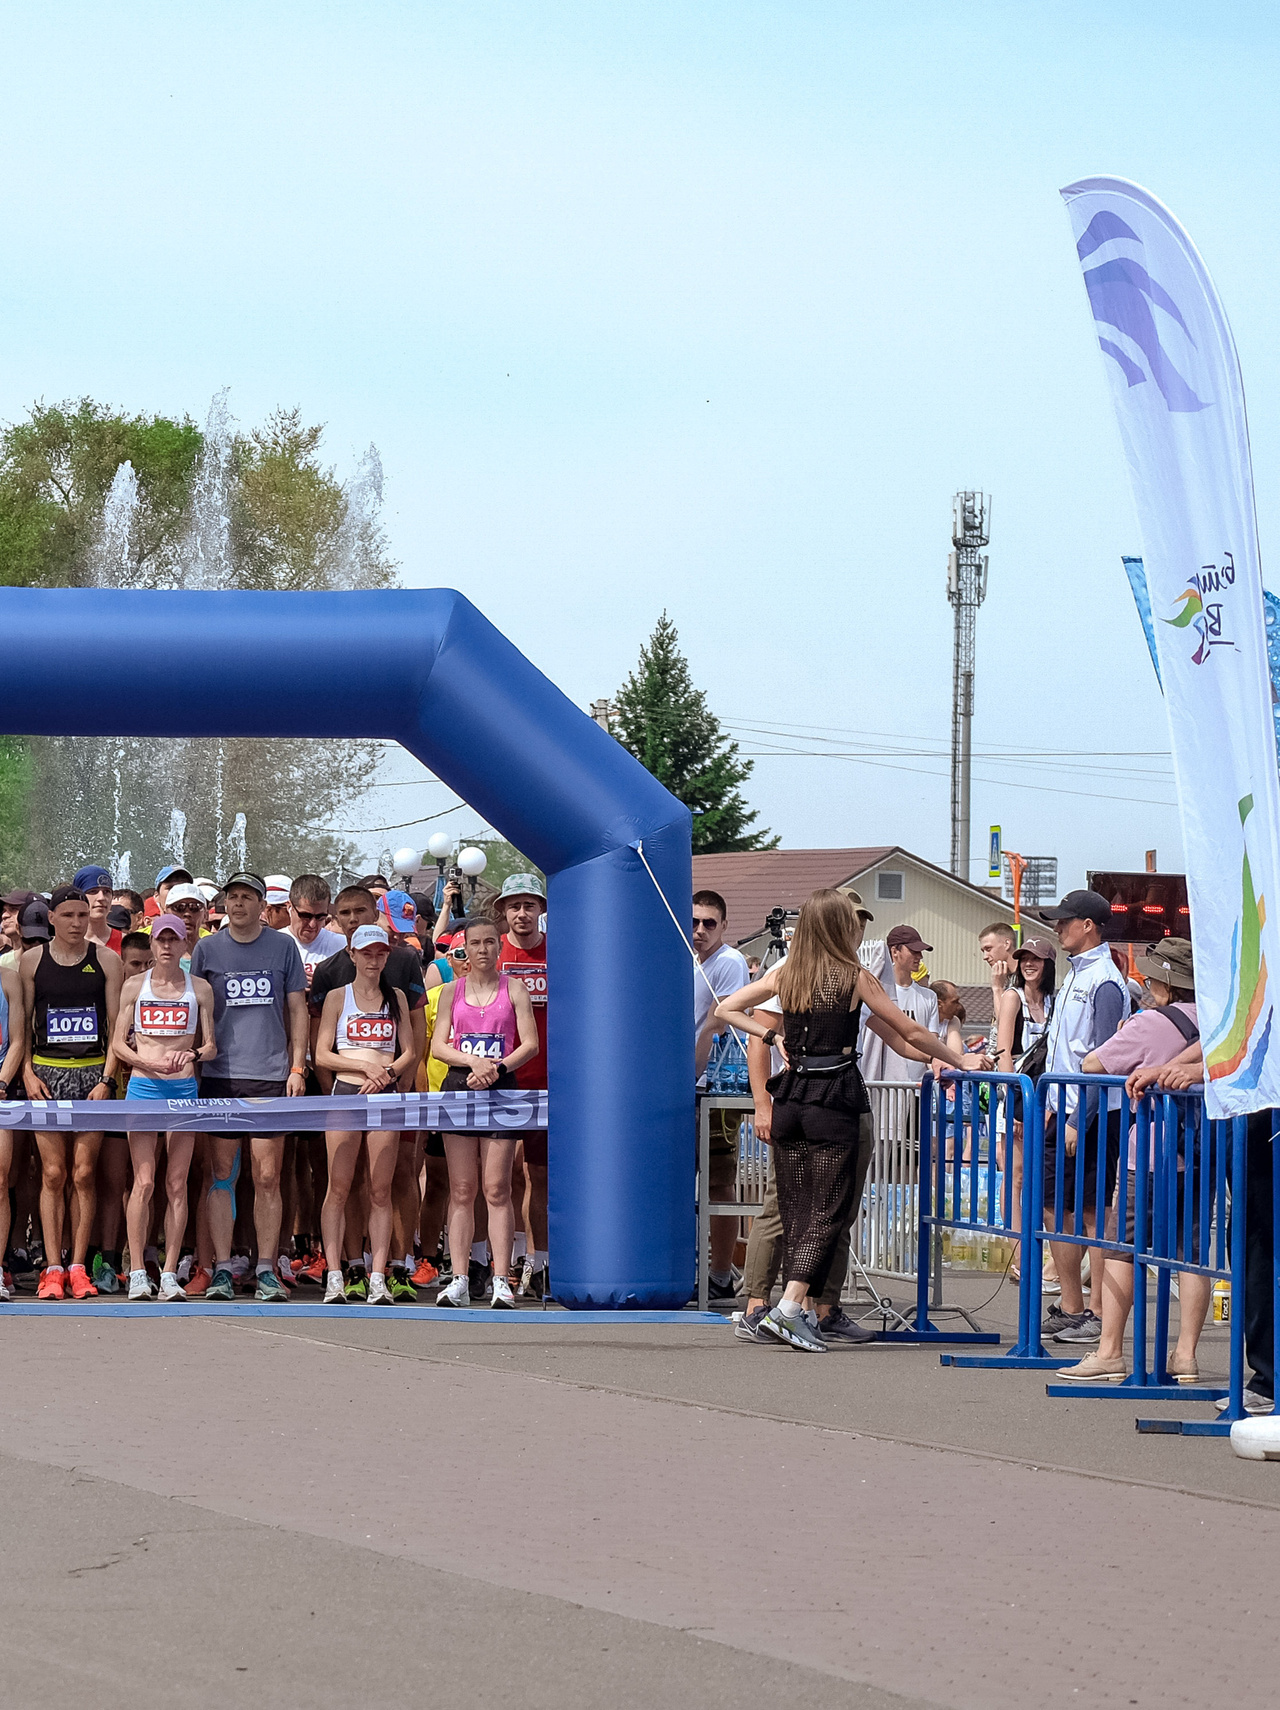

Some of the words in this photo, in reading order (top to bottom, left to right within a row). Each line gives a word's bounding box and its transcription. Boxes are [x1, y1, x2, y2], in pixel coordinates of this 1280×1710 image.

[226, 978, 272, 998] 999
[518, 977, 547, 992] 30
[49, 1017, 94, 1034] 1076
[142, 1010, 188, 1027] 1212
[348, 1021, 394, 1039] 1348
[460, 1040, 502, 1059] 944
[365, 1089, 548, 1127] FINIS
